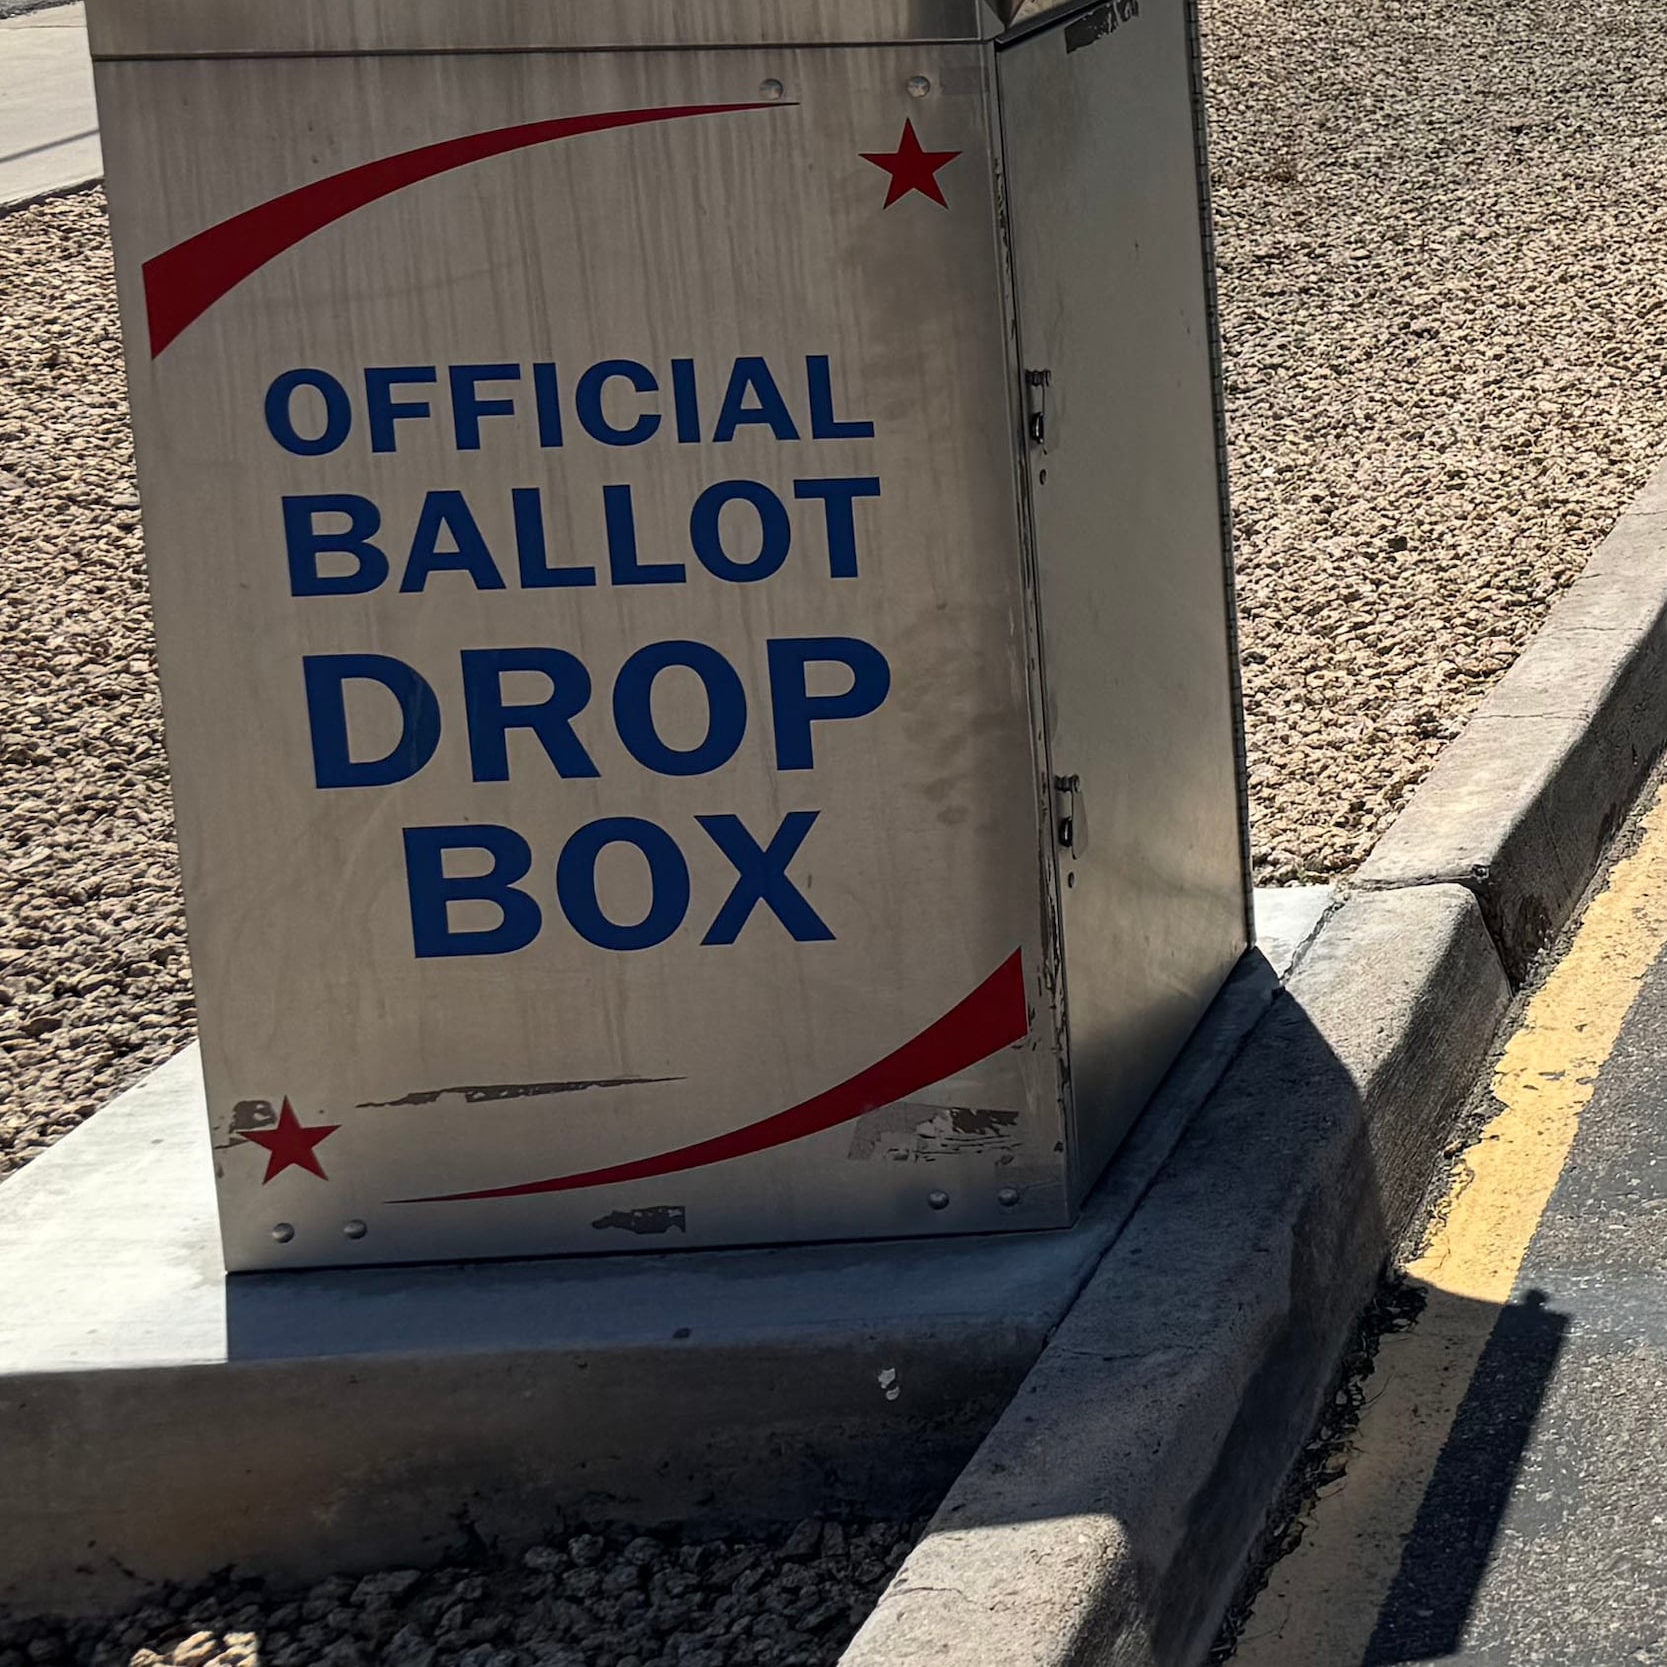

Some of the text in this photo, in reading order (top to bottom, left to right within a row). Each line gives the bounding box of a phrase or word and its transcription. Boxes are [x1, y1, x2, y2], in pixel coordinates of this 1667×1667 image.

[264, 355, 875, 457] OFFICIAL
[281, 477, 881, 597] BALLOT
[302, 636, 891, 790] DROP
[402, 810, 836, 959] BOX
